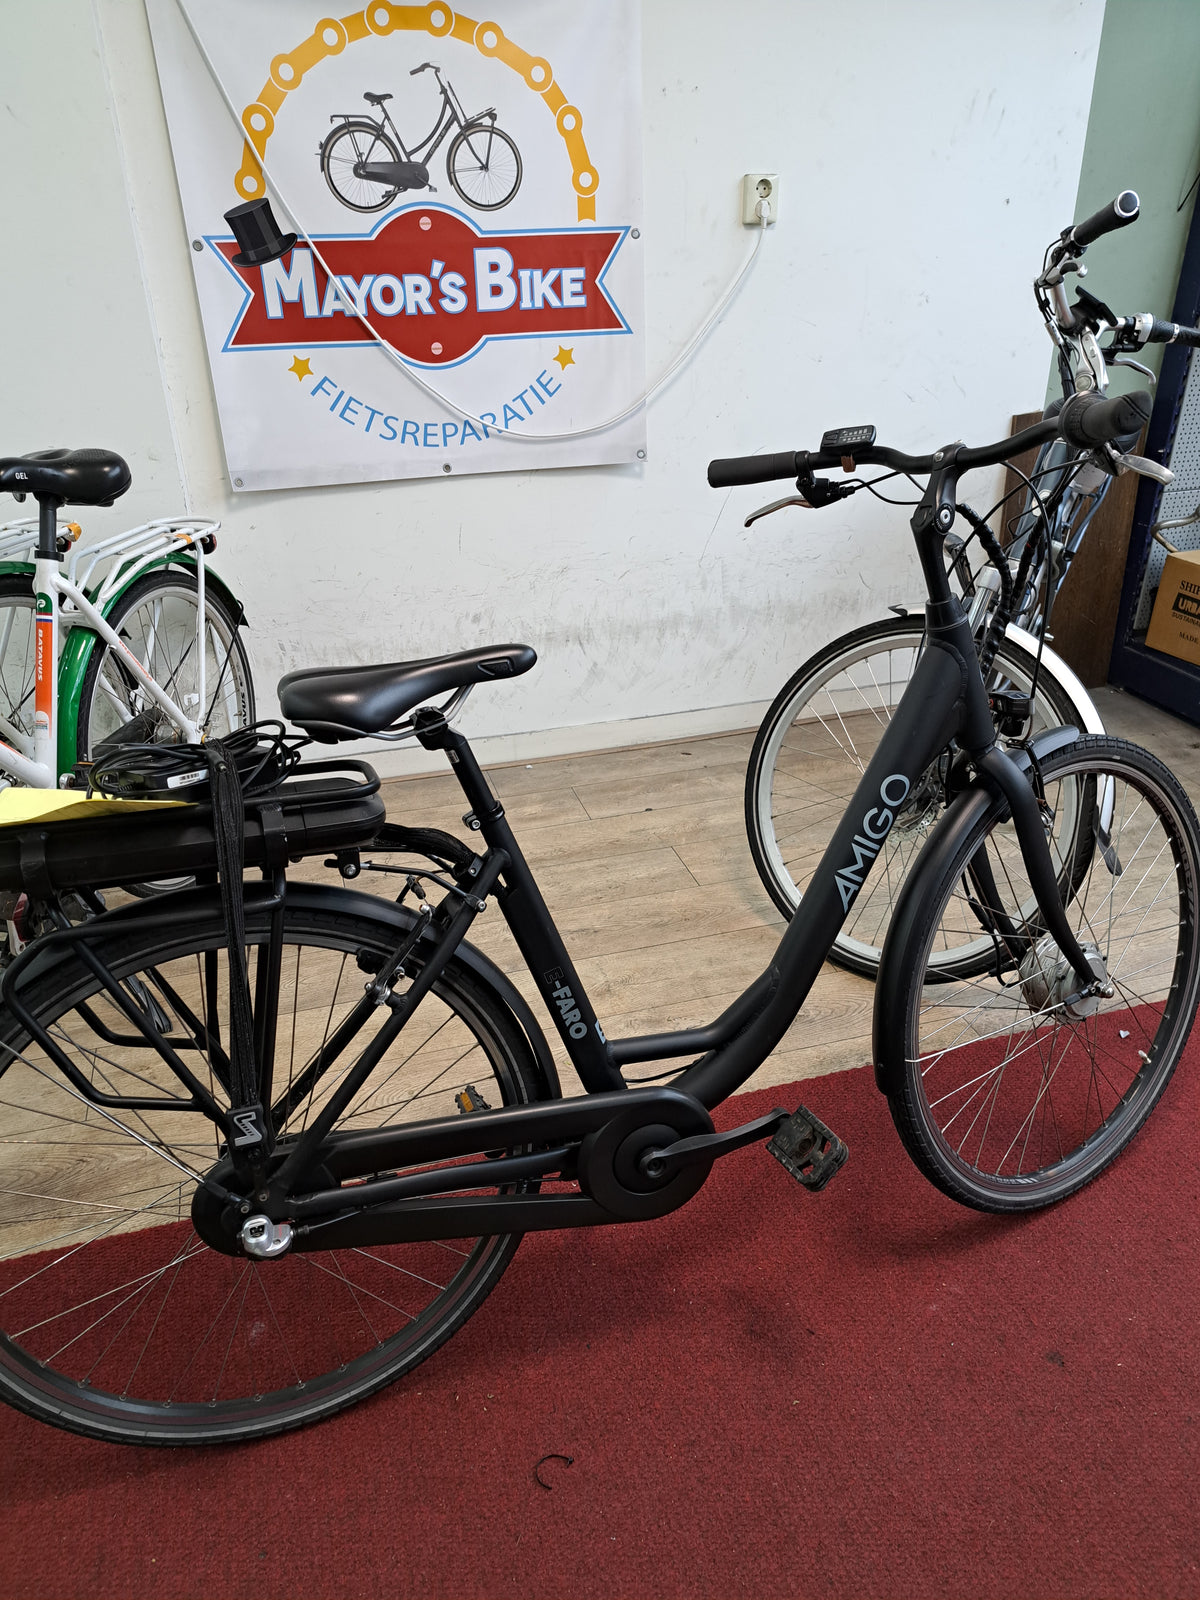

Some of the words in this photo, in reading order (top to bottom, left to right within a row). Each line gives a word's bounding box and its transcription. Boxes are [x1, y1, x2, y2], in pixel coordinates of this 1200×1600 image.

[473, 247, 587, 312] BIKE
[310, 370, 563, 448] FIETSREPARATIE
[834, 774, 911, 913] AMIGO
[544, 966, 588, 1039] E-FARO
